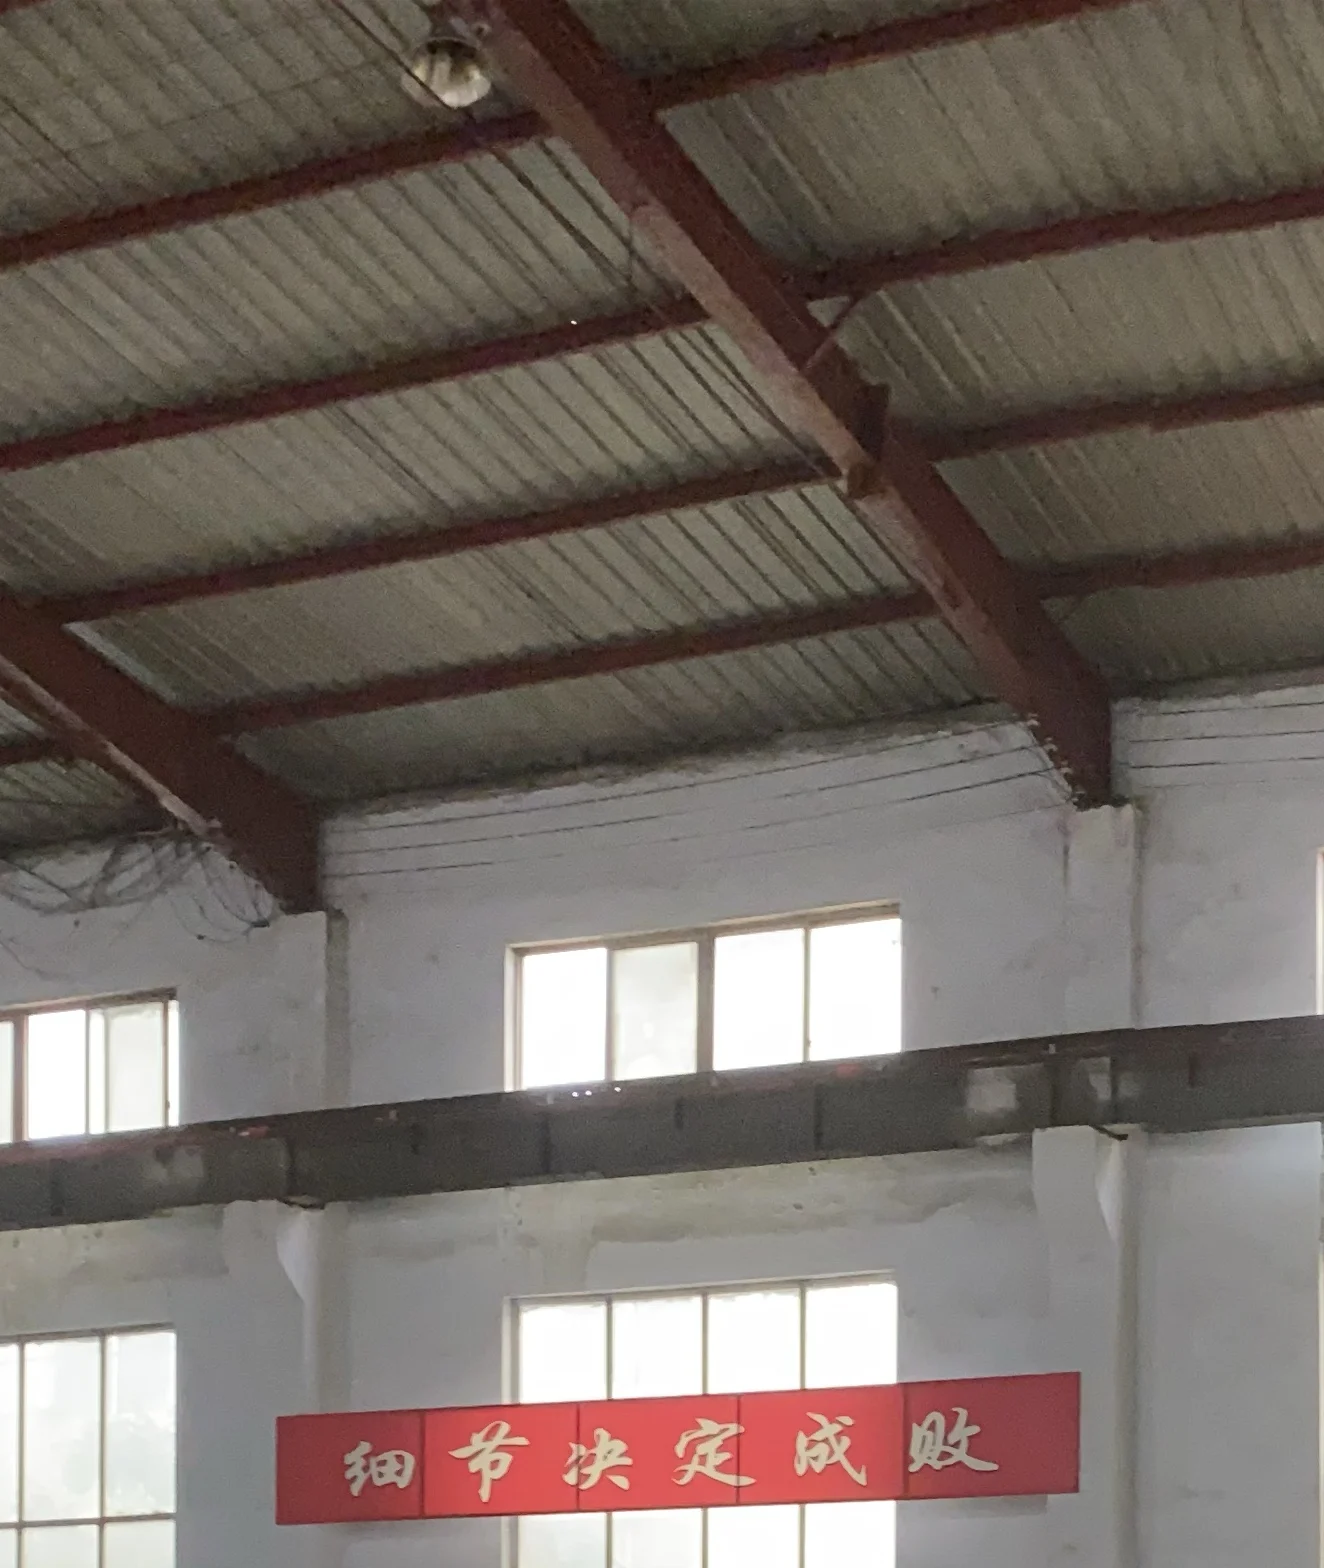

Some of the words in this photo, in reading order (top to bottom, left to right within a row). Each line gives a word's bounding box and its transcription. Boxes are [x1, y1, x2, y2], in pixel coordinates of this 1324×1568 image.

[343, 1406, 1000, 1503] 细节决定成败
